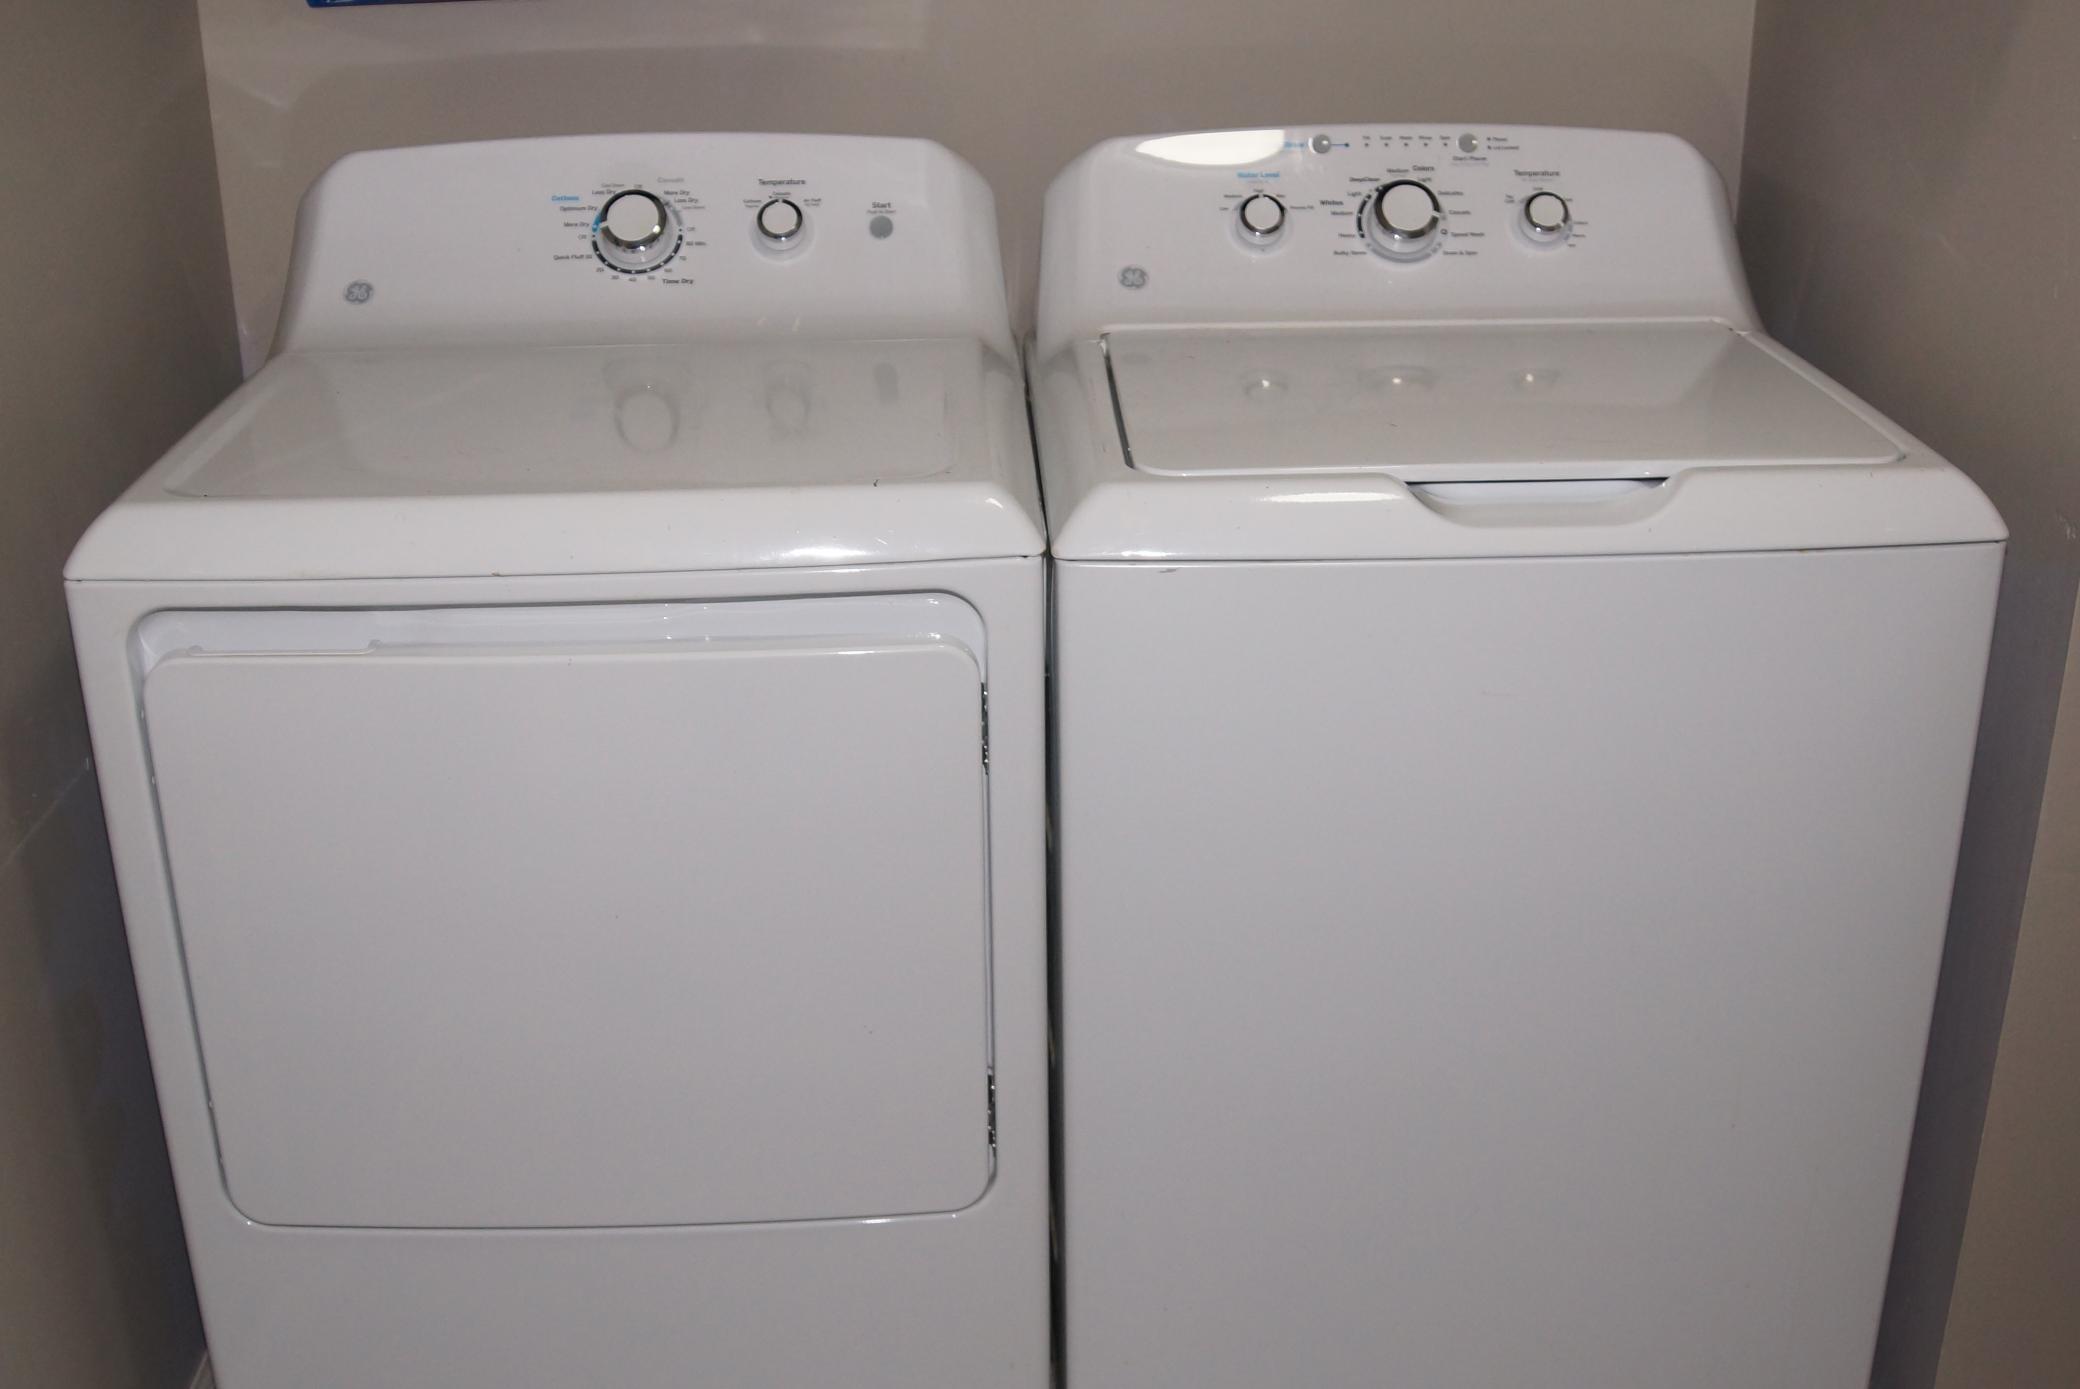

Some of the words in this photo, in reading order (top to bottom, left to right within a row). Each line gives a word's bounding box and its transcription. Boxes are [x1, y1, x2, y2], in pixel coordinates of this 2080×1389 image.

[1513, 169, 1560, 177] Temperature
[758, 178, 806, 186] Temperature
[871, 201, 891, 209] Start
